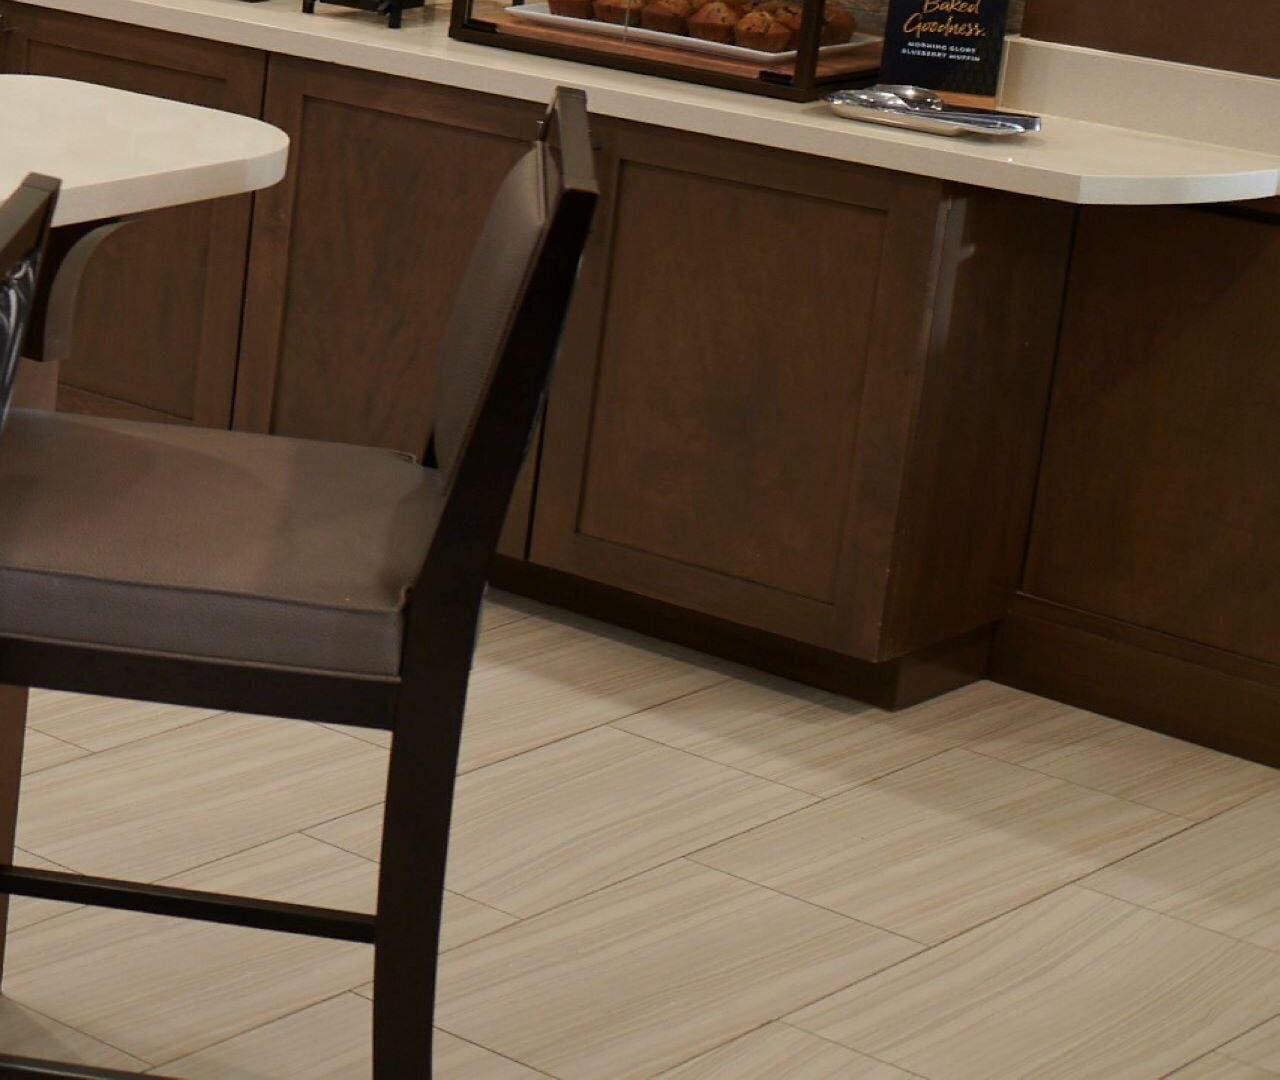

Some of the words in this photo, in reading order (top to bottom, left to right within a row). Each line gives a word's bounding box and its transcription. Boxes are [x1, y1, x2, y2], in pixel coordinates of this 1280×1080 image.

[903, 12, 987, 39] Goodness.
[901, 47, 947, 59] BLUEBERRY
[949, 53, 981, 62] MUFFIN
[907, 41, 947, 51] MORNING
[949, 45, 976, 54] GLORY
